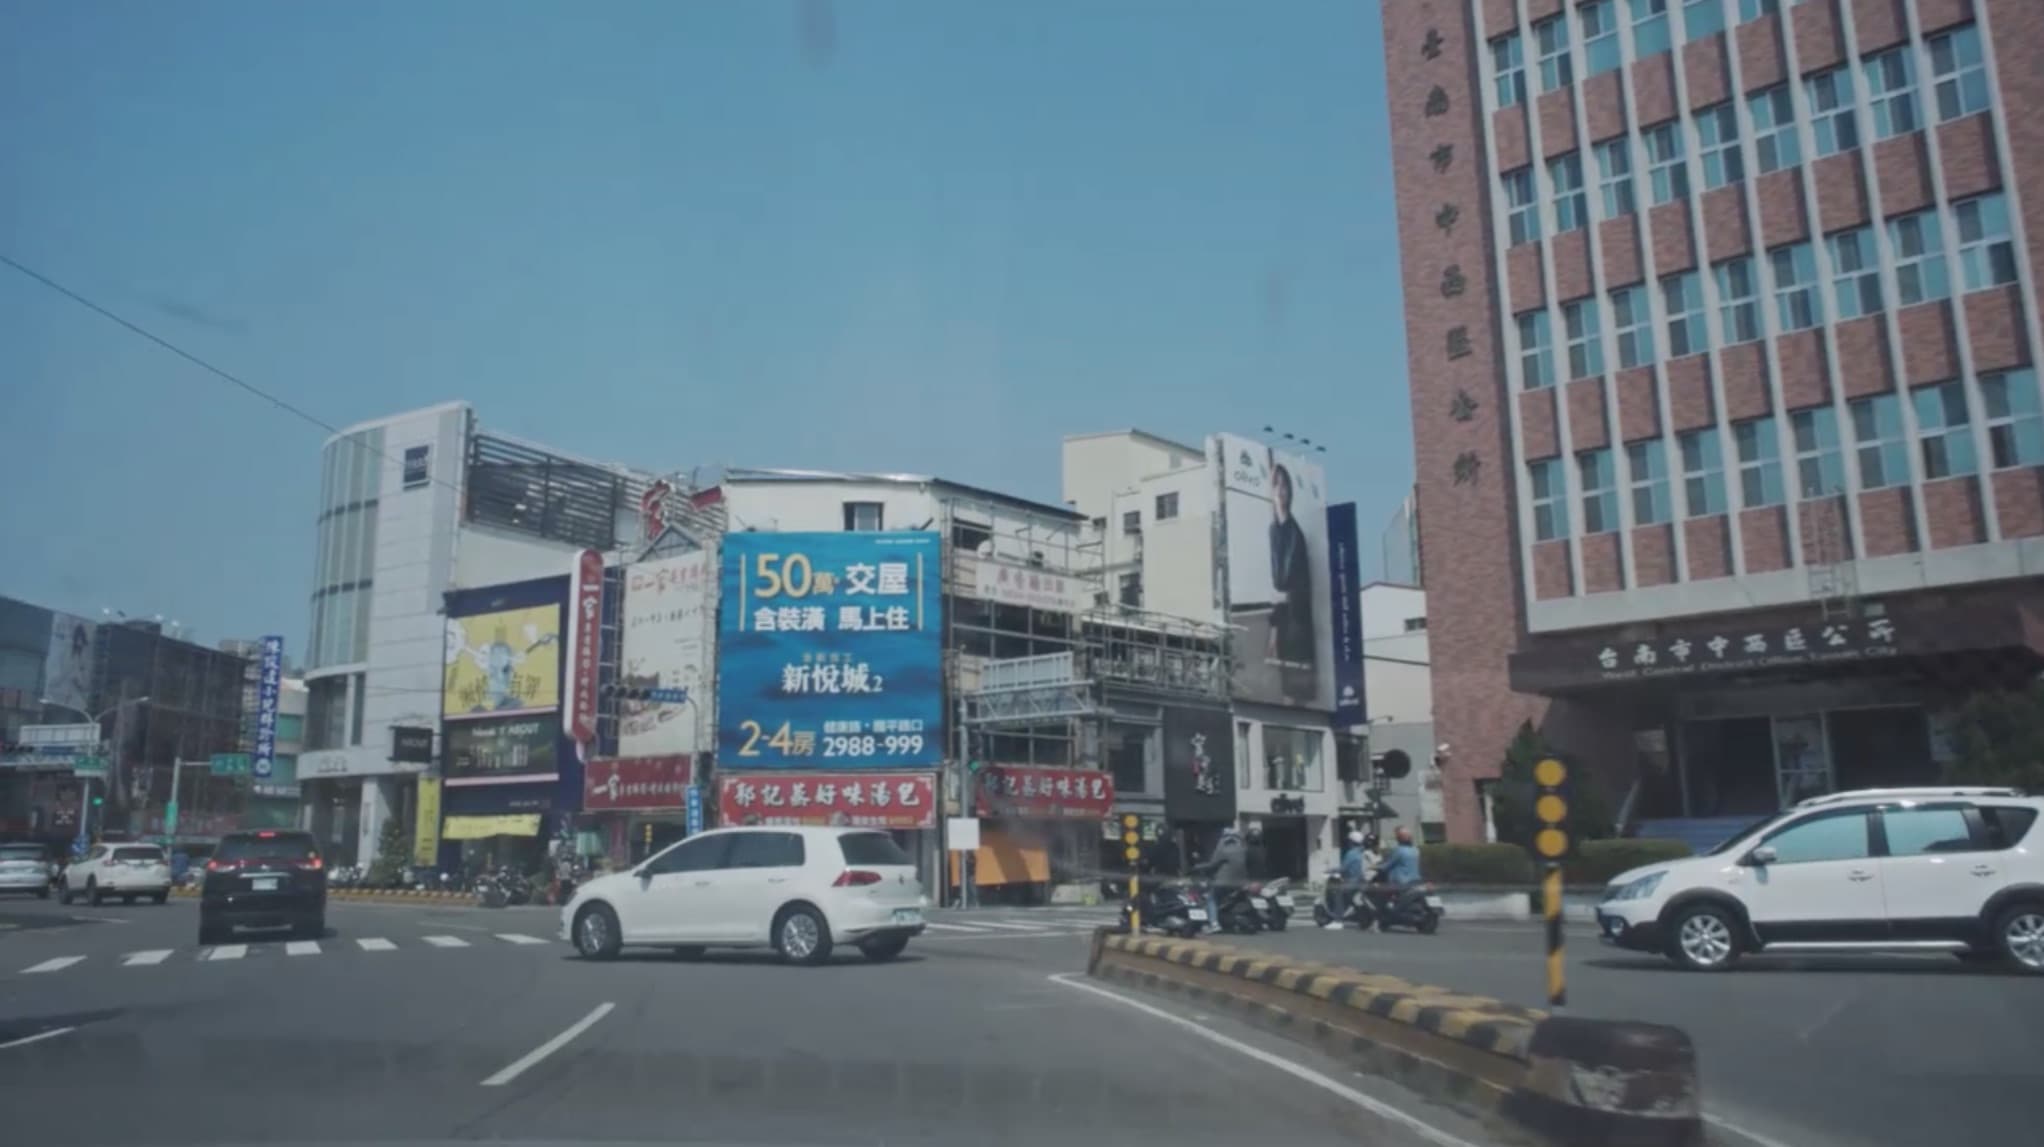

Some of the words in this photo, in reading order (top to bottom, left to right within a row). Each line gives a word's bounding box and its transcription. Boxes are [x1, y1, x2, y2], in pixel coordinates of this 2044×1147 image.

[845, 562, 909, 595] 交屋
[754, 607, 825, 632] 含裝潢
[838, 606, 909, 631] 馬上住
[738, 720, 817, 757] 2-4房
[823, 735, 923, 758] 2988-999
